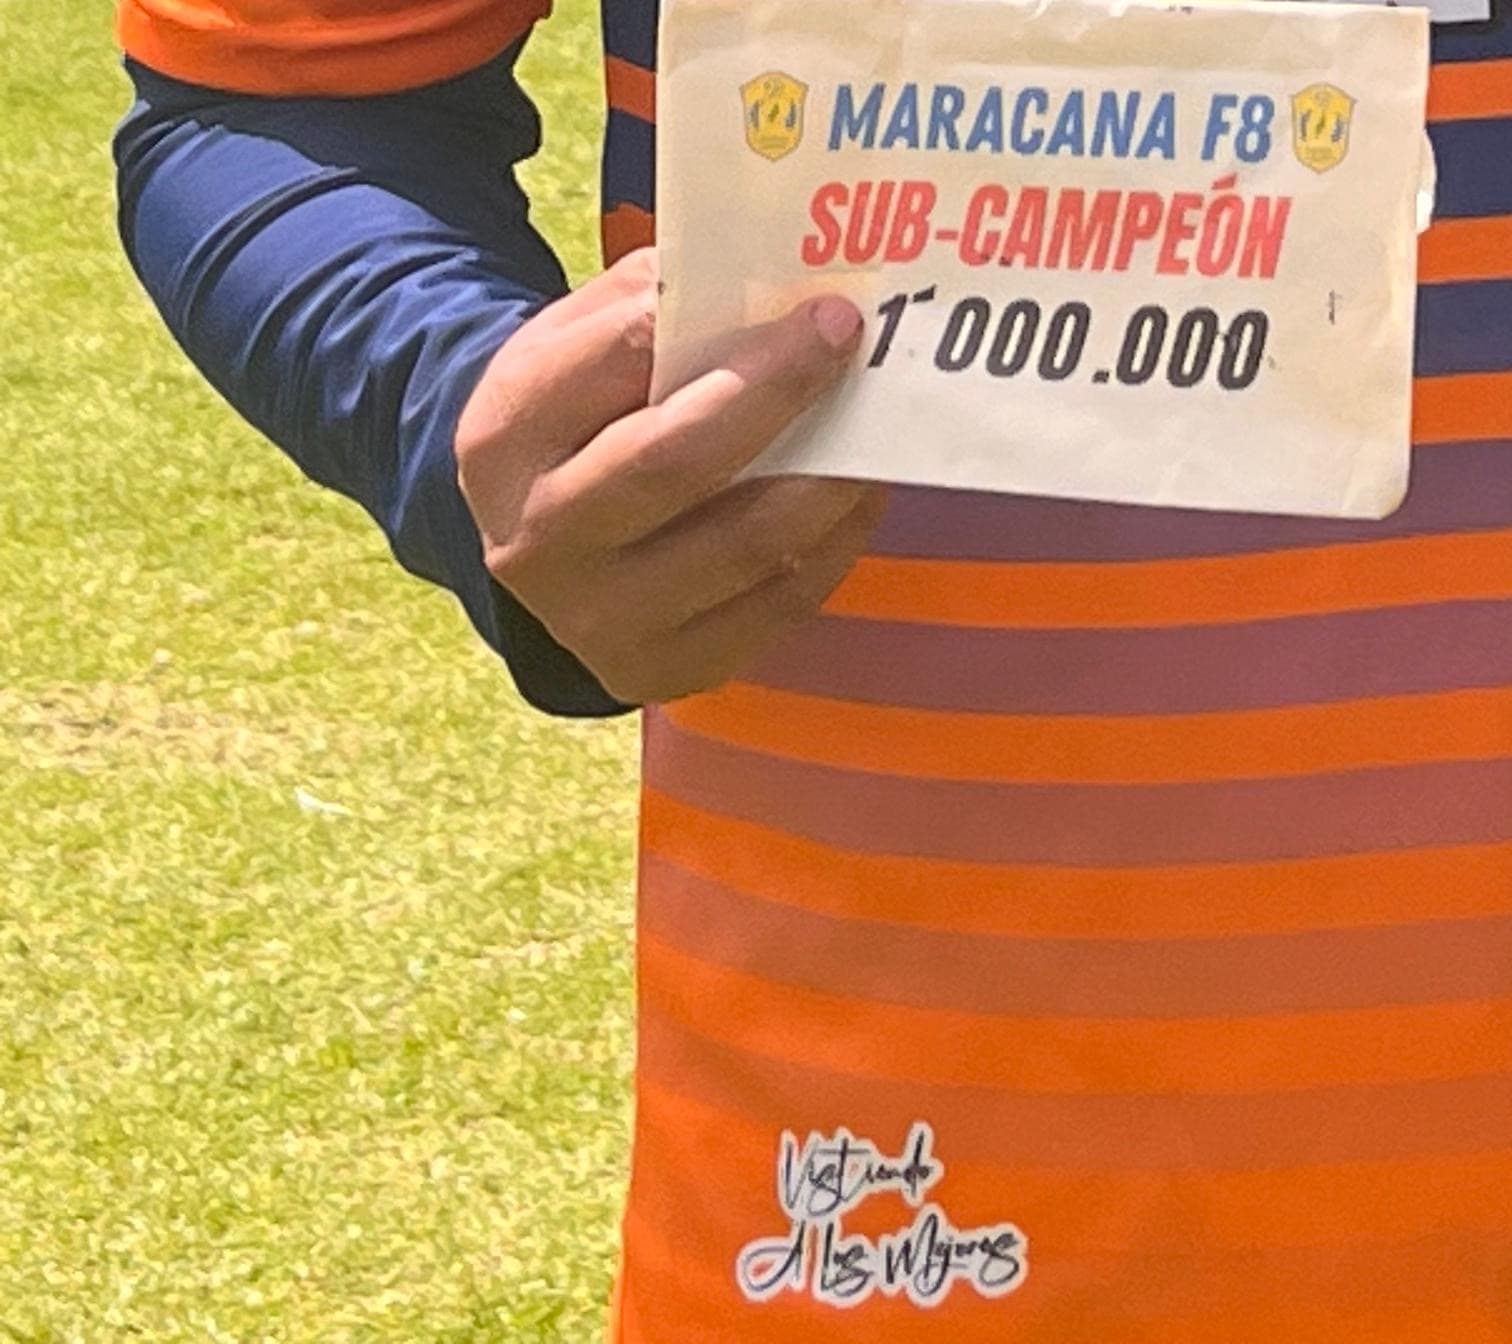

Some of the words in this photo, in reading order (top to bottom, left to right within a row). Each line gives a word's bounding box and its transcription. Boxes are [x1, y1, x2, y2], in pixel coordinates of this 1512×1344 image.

[828, 82, 1177, 161] MARACANA
[1201, 95, 1275, 165] F8
[800, 173, 1294, 280] SUB-CAMPEÓN
